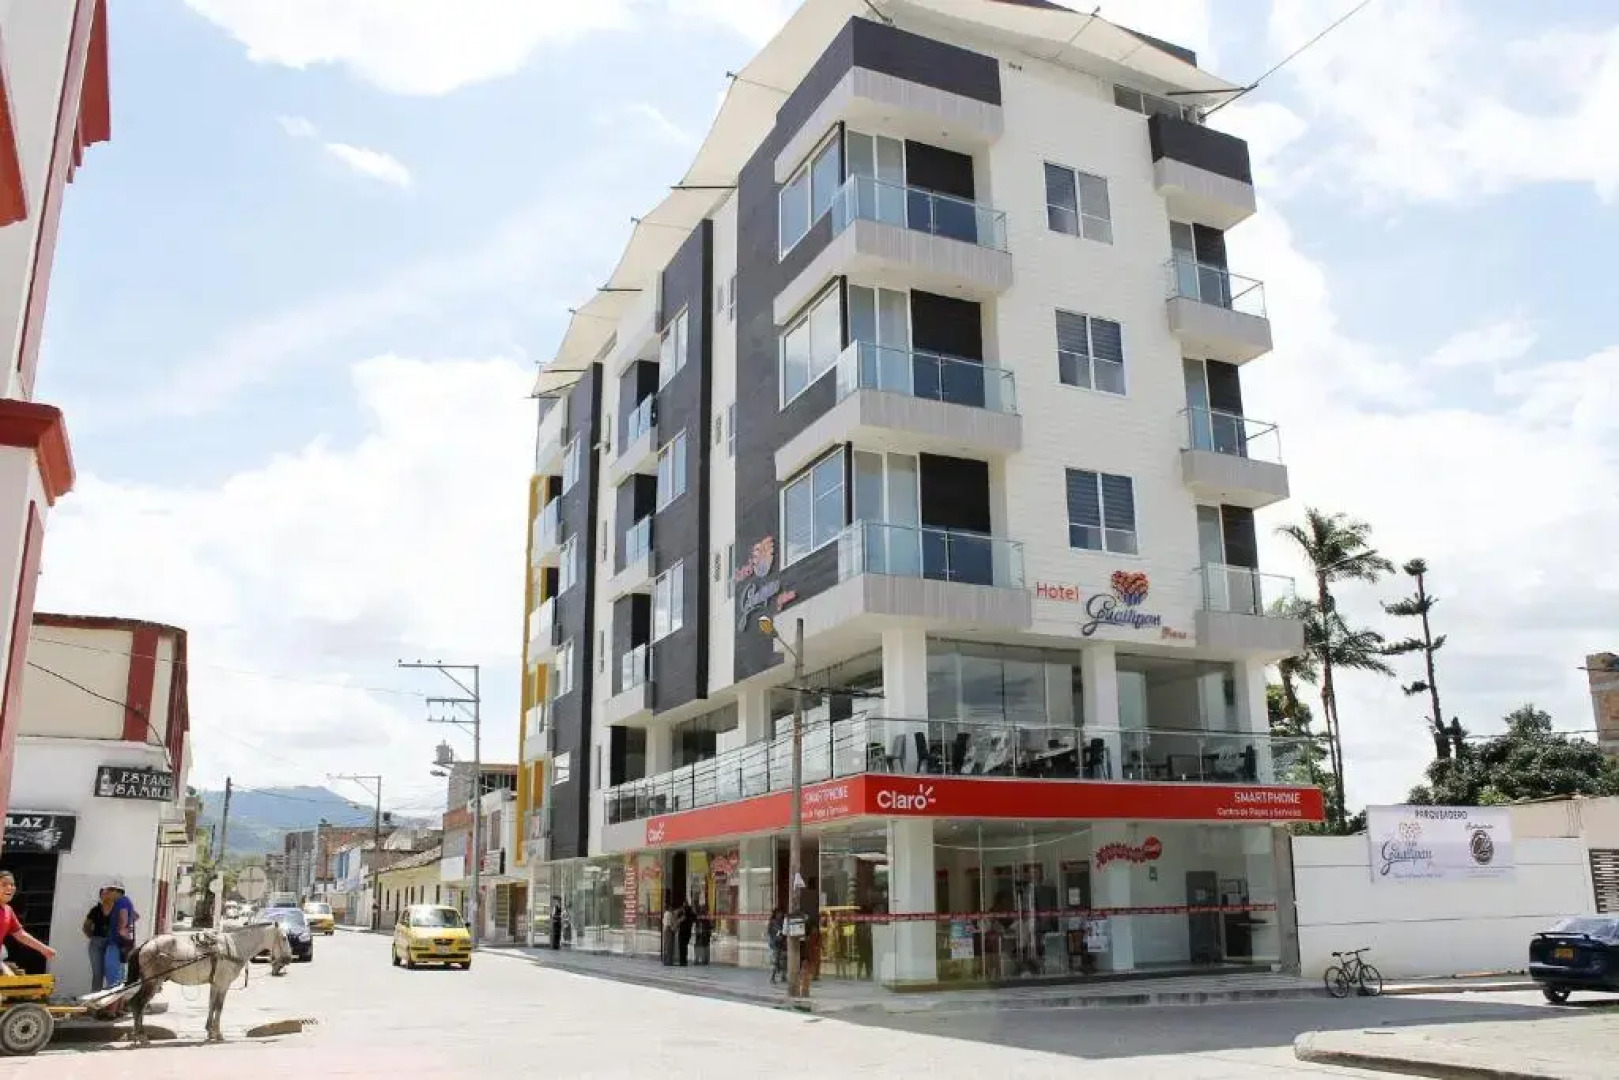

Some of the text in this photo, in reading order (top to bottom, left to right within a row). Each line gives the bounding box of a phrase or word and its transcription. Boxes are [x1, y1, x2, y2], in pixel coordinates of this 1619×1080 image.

[1036, 582, 1079, 601] Hotel
[877, 790, 927, 809] Claro
[1234, 791, 1301, 804] SMARTPHONE
[1415, 808, 1468, 820] PARQUEADERO
